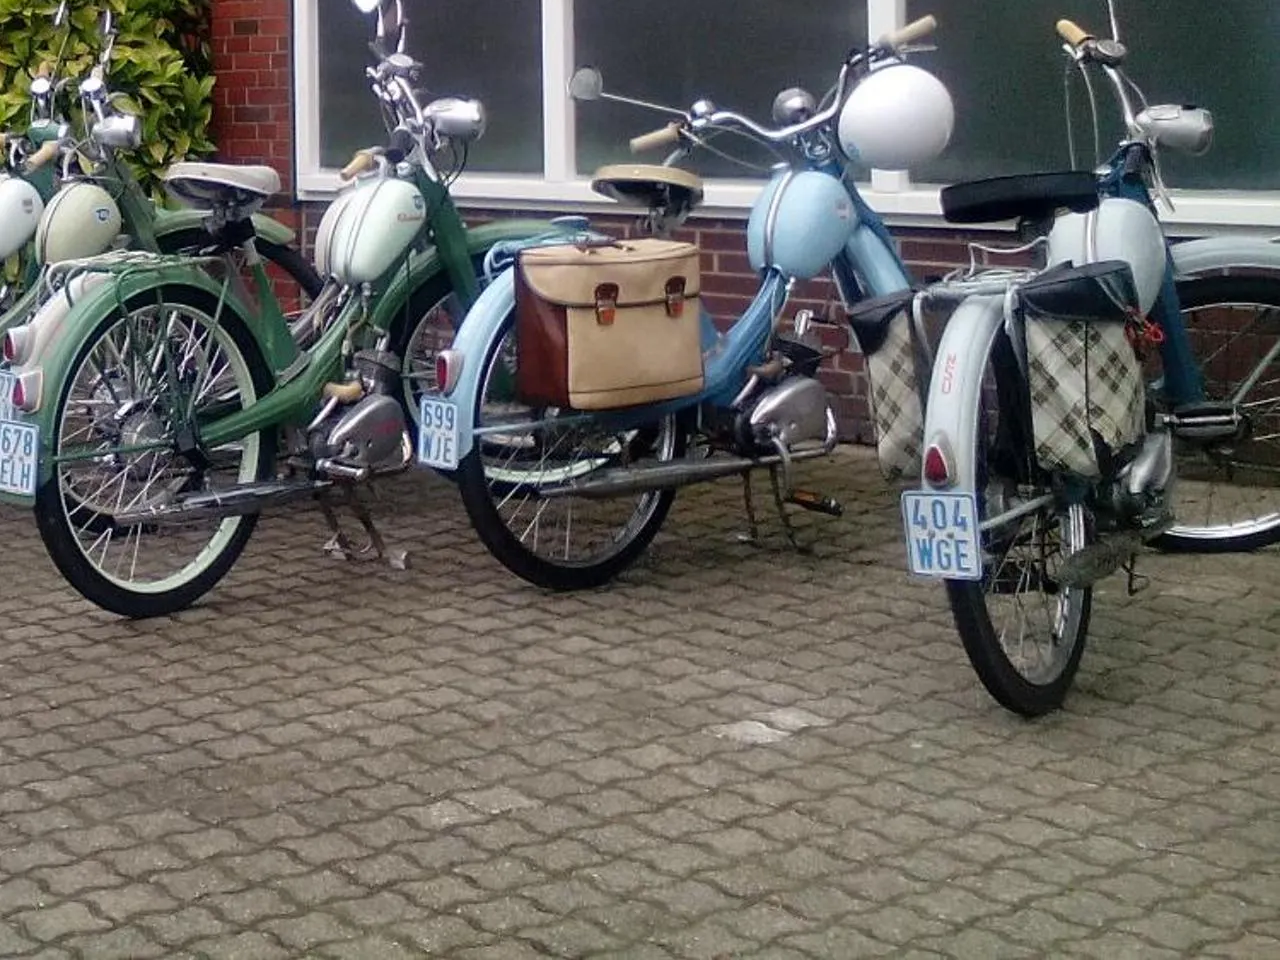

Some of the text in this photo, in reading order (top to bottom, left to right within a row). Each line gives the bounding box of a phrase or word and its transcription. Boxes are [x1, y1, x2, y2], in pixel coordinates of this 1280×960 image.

[424, 403, 455, 431] 699
[1, 426, 33, 457] 678
[0, 458, 31, 489] ELH
[912, 499, 968, 531] 404
[915, 539, 971, 572] WGE
